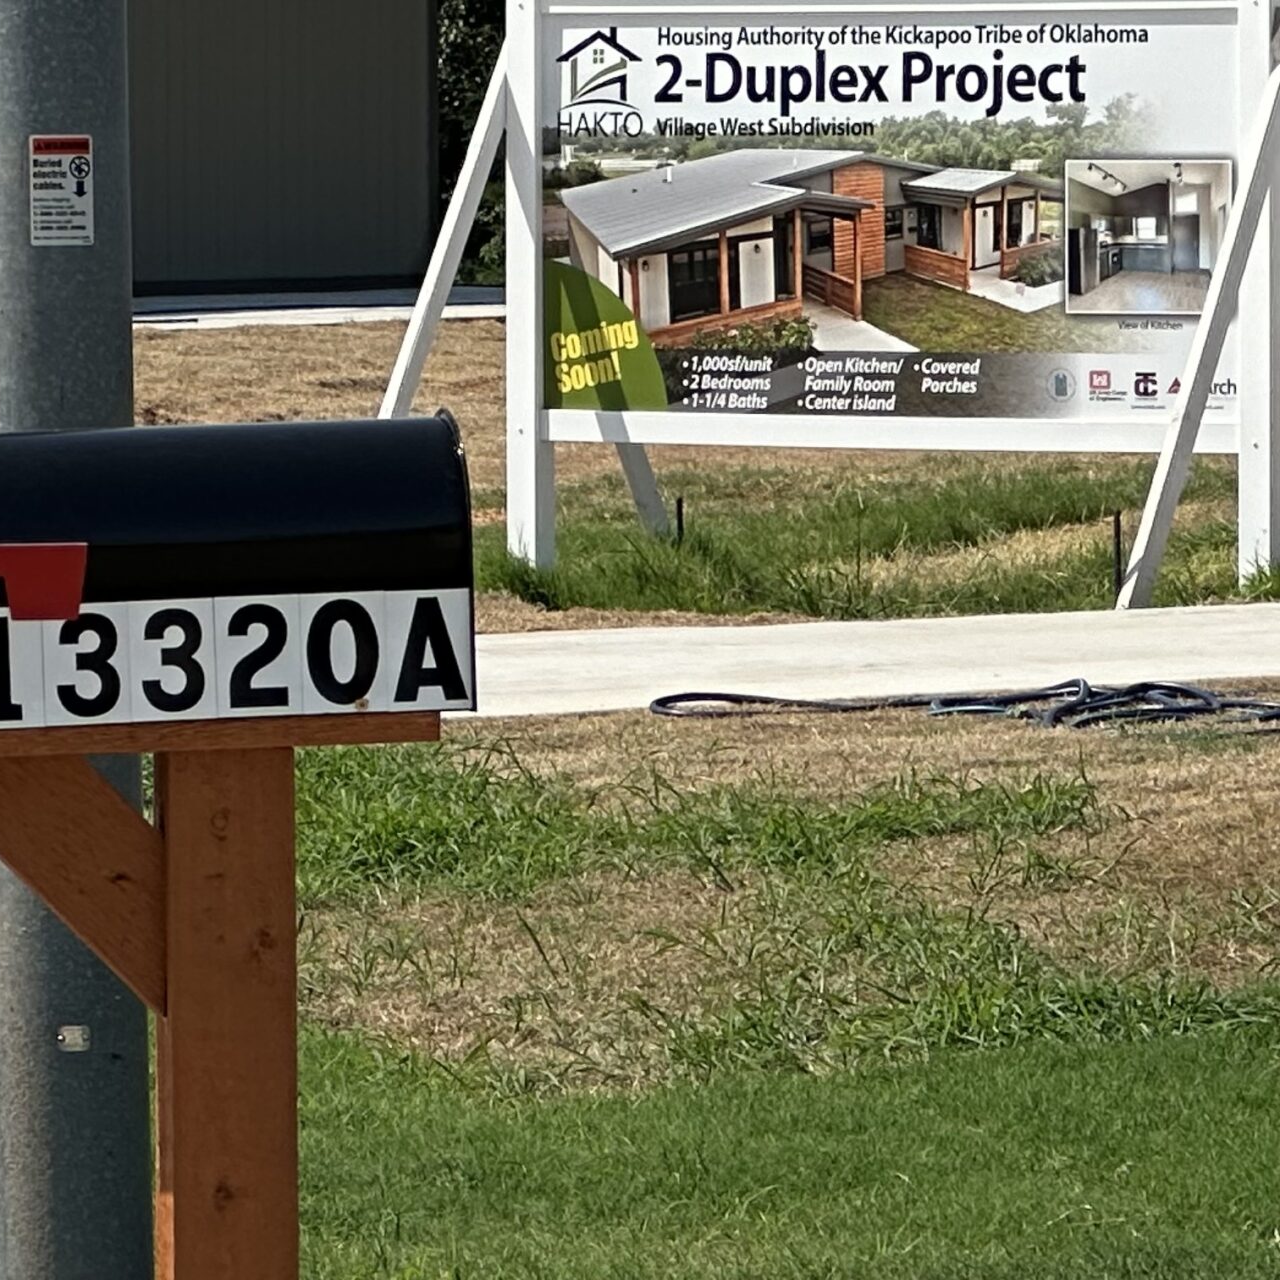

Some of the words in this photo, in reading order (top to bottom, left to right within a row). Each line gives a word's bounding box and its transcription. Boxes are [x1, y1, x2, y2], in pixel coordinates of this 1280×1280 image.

[658, 27, 732, 49] Housing
[737, 26, 824, 49] Authority
[829, 26, 849, 44] of
[852, 26, 881, 44] the
[886, 25, 971, 48] Kickapoo
[975, 24, 1021, 44] Tribe
[1027, 24, 1047, 43] of
[1050, 23, 1148, 43] Oklahoma
[654, 50, 889, 116] 2-Duplex
[902, 49, 1086, 117] Project
[558, 111, 643, 138] HAKTO
[658, 117, 717, 140] Village
[721, 116, 767, 135] West
[769, 116, 874, 136] Subdivision
[550, 320, 639, 362] Coming
[555, 351, 622, 393] Soon!
[691, 355, 773, 373] 1,000sf/unit
[805, 357, 842, 375] Open
[844, 357, 904, 375] Kitchen/
[921, 358, 981, 375] Covered
[690, 375, 699, 389] 2
[701, 375, 771, 390] Bedrooms
[805, 376, 851, 394] Family
[854, 377, 895, 392] Room
[921, 377, 977, 393] Porches
[691, 393, 725, 408] 1-1/4
[728, 393, 768, 408] Baths
[805, 394, 850, 410] Center
[852, 395, 896, 411] island
